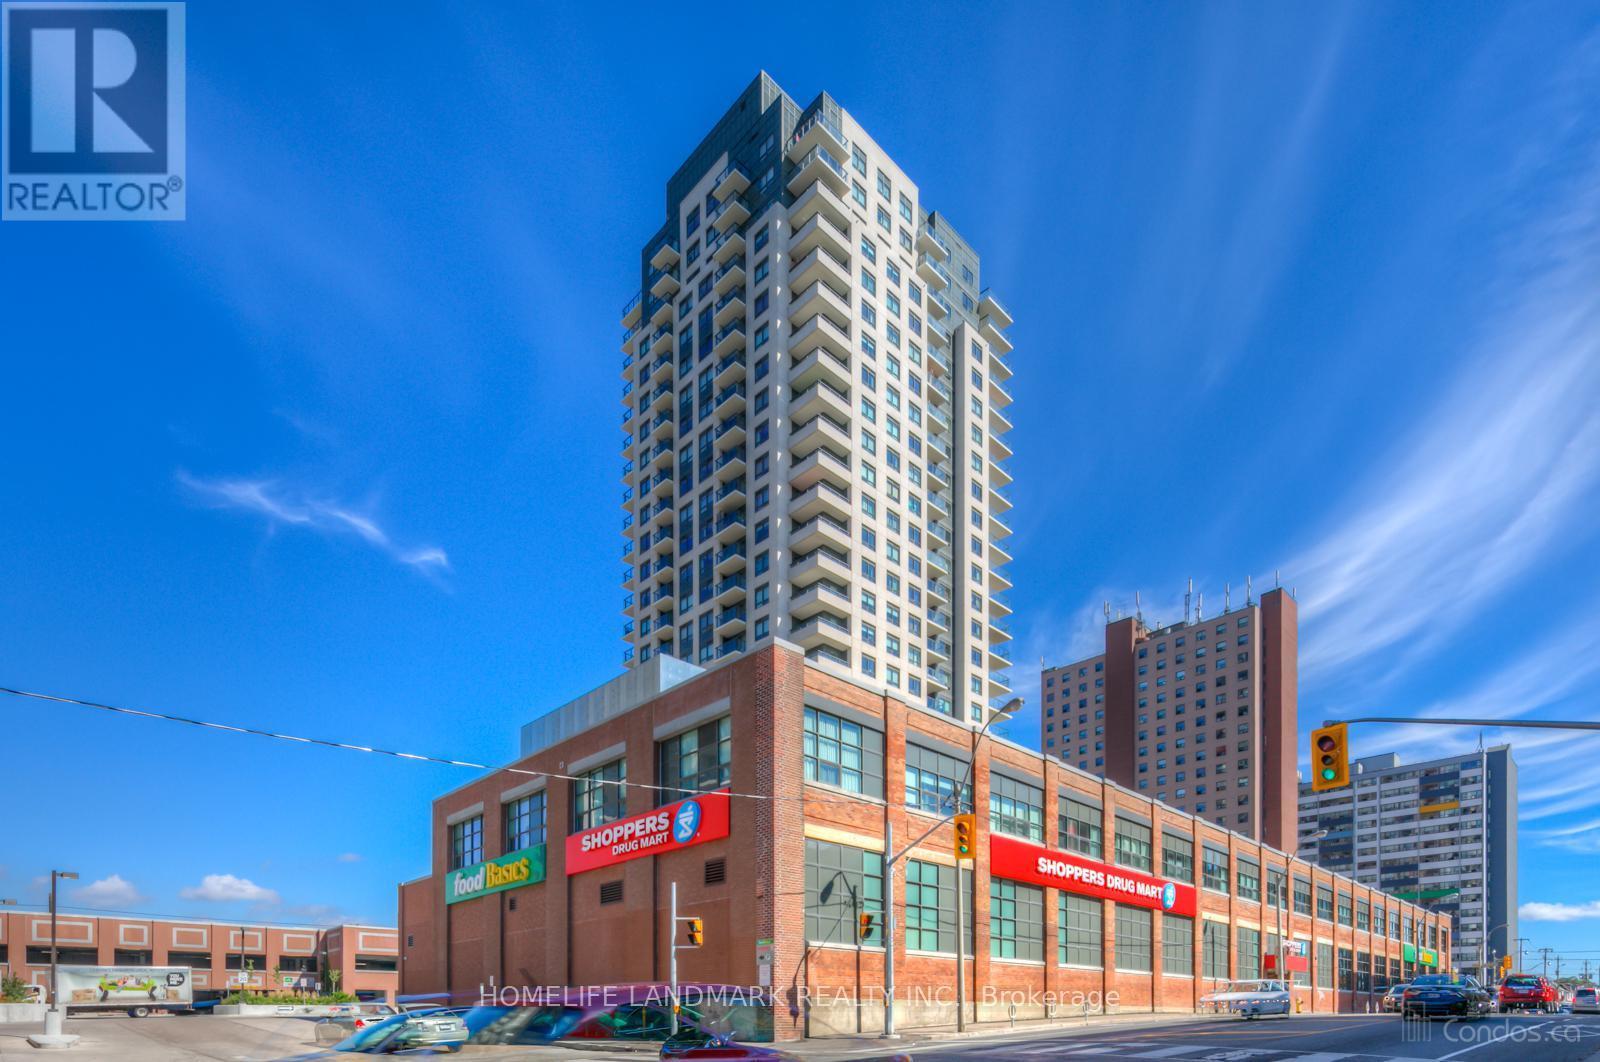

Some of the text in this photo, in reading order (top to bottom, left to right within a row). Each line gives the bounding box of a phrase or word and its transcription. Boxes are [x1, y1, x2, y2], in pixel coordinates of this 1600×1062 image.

[581, 812, 669, 852] SHOPPERS
[612, 832, 669, 856] DRUG MART
[454, 866, 485, 897] food
[1037, 857, 1163, 899] SHOPPERS DRUG MART
